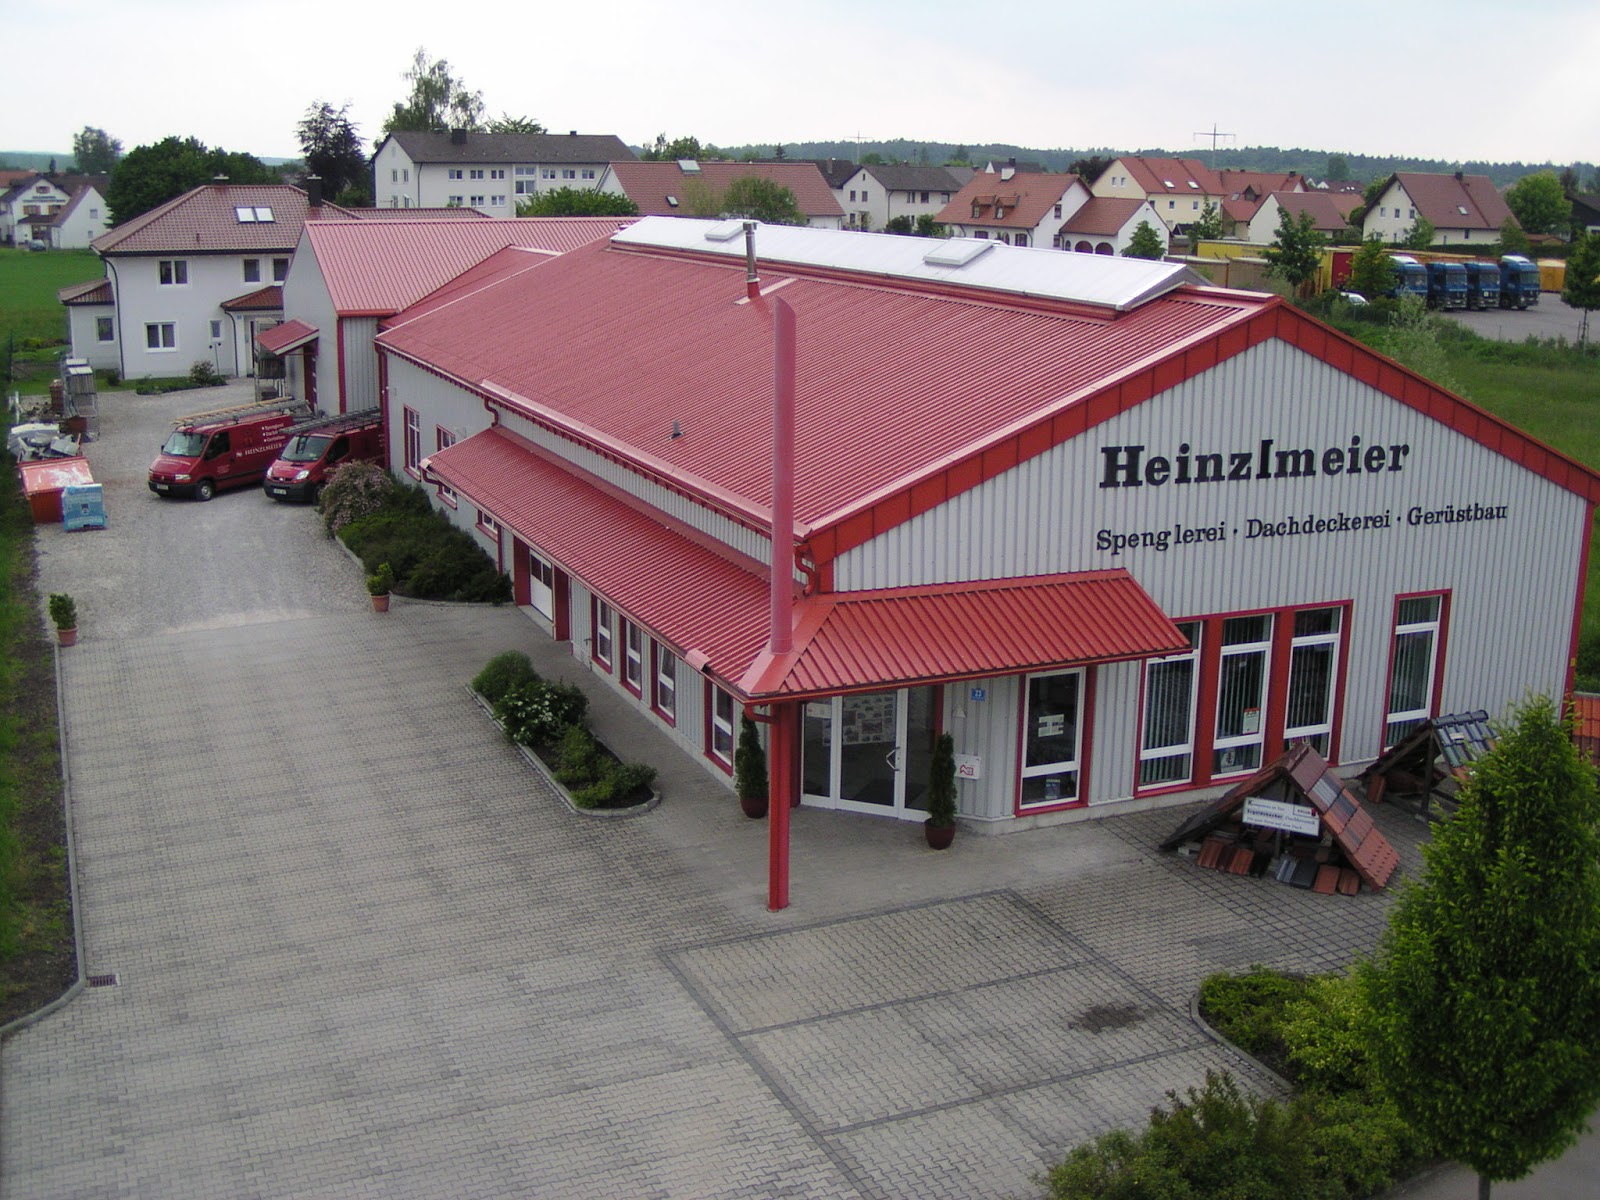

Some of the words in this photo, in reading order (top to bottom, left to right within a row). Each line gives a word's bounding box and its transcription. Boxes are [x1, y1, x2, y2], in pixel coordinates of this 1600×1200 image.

[1099, 436, 1410, 488] Heinzlmeier
[1096, 521, 1226, 555] Spenglerei
[1246, 510, 1391, 539] Dachdeckerei
[1407, 503, 1508, 526] Gerüstbau
